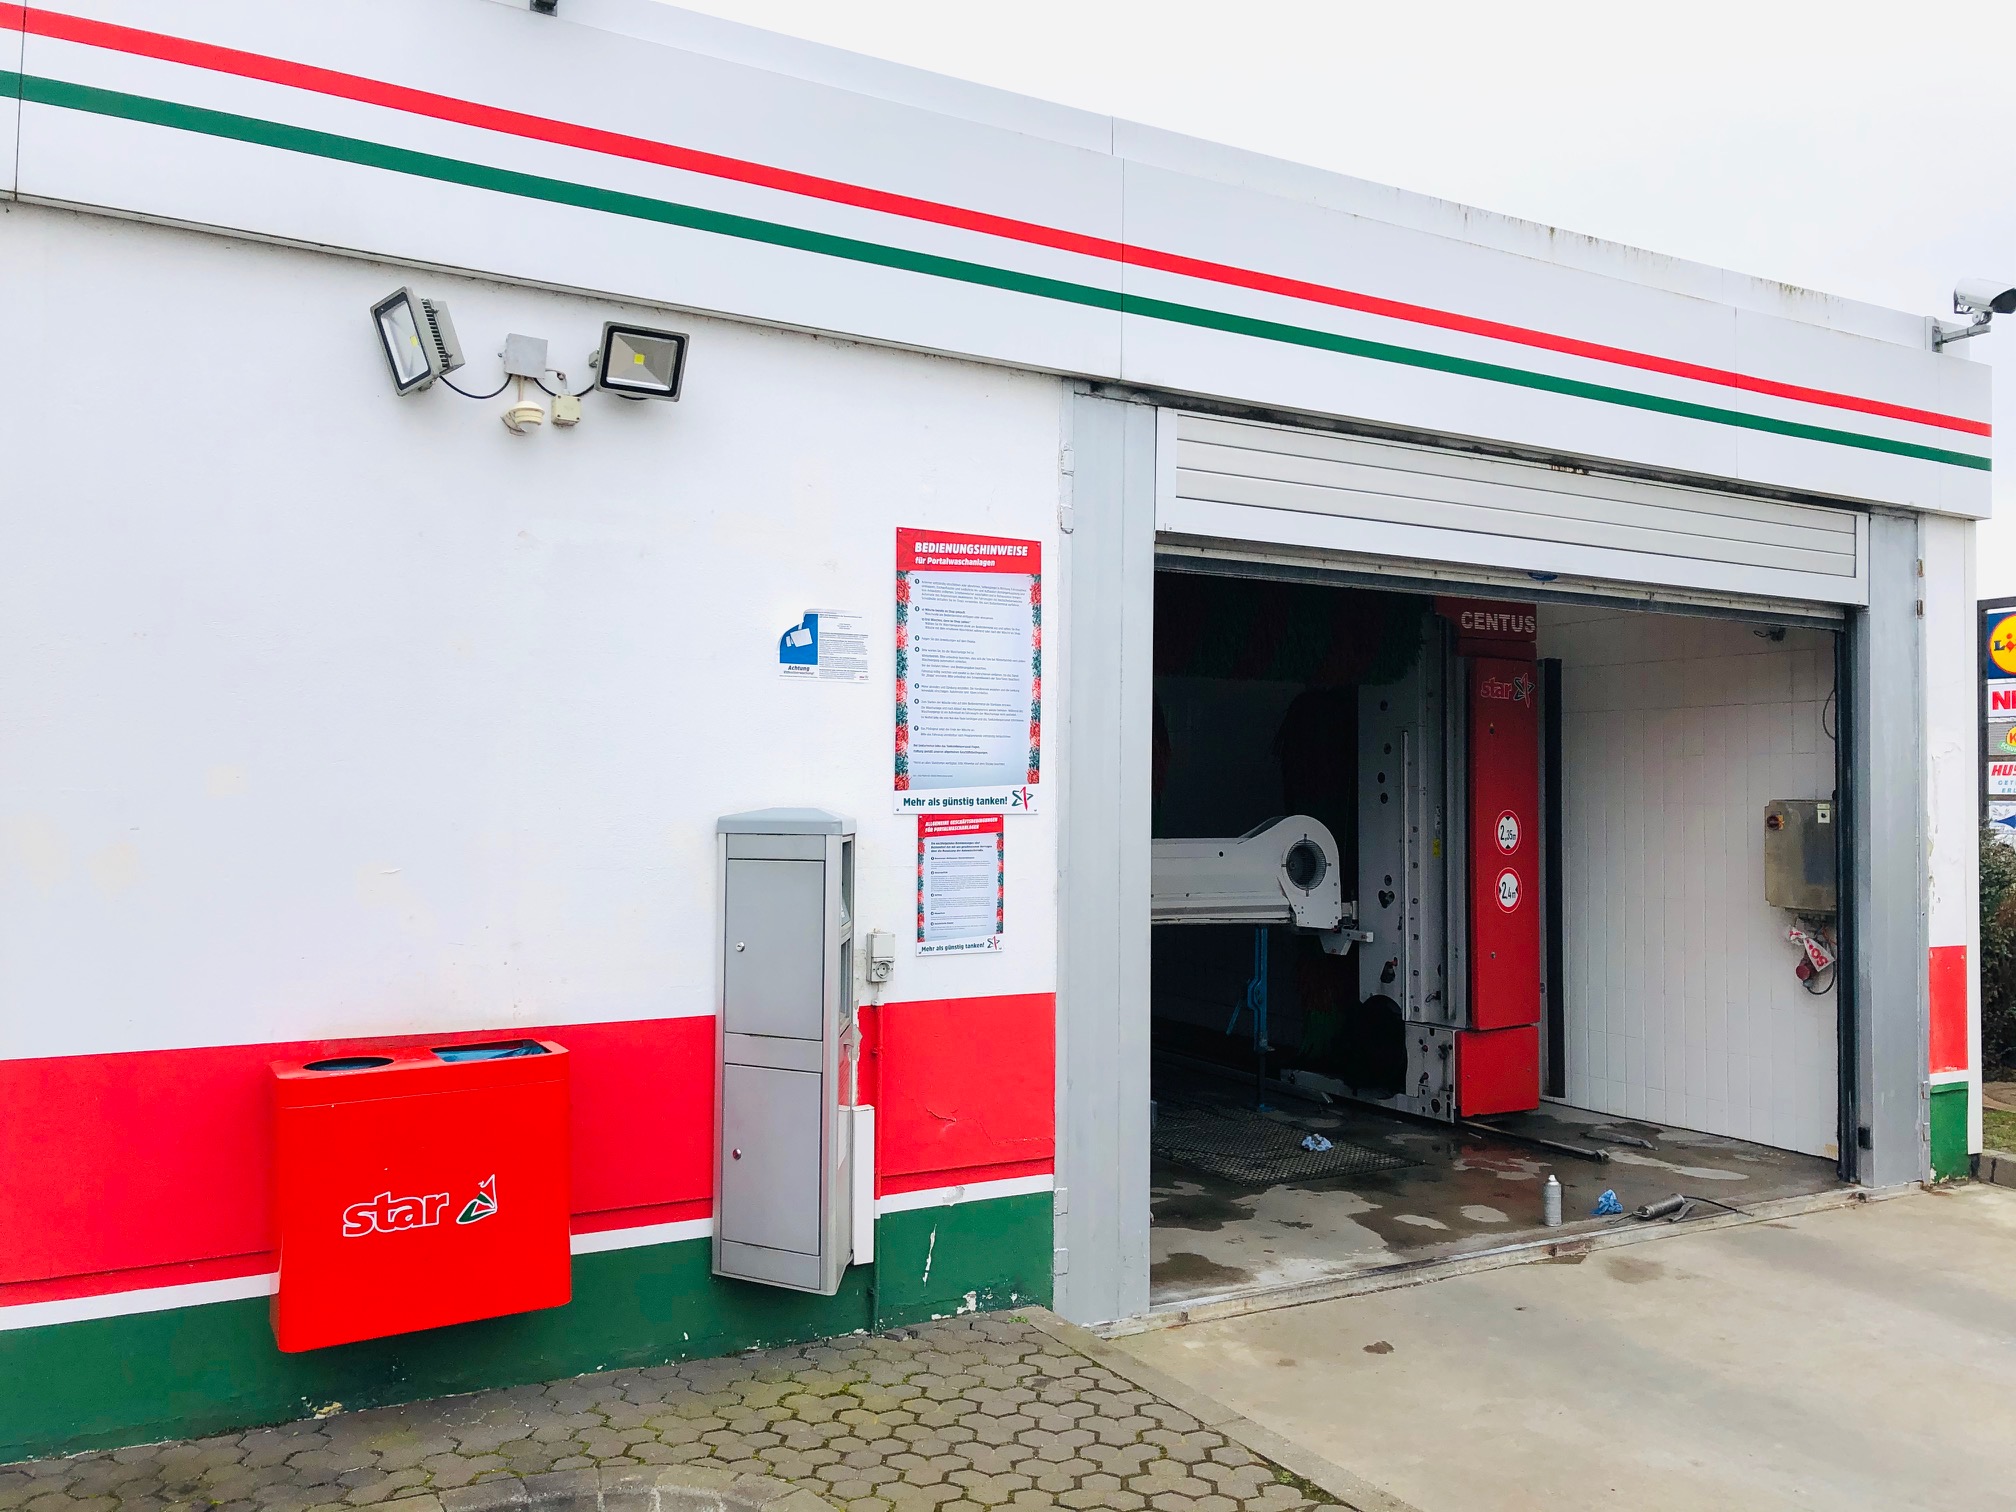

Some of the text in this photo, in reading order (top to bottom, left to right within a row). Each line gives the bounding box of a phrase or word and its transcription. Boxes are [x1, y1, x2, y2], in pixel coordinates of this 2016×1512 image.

[914, 542, 1028, 557] BEDIENUNGSHINWEISE
[915, 556, 995, 567] für Portalwaschanlagen
[1461, 611, 1536, 633] CENTUS
[1480, 677, 1513, 699] star
[903, 796, 1008, 807] Mehr als günstig tanken!
[935, 944, 944, 952] als
[944, 943, 964, 952] günstig
[965, 942, 985, 950] tanken!
[343, 1191, 450, 1237] star
